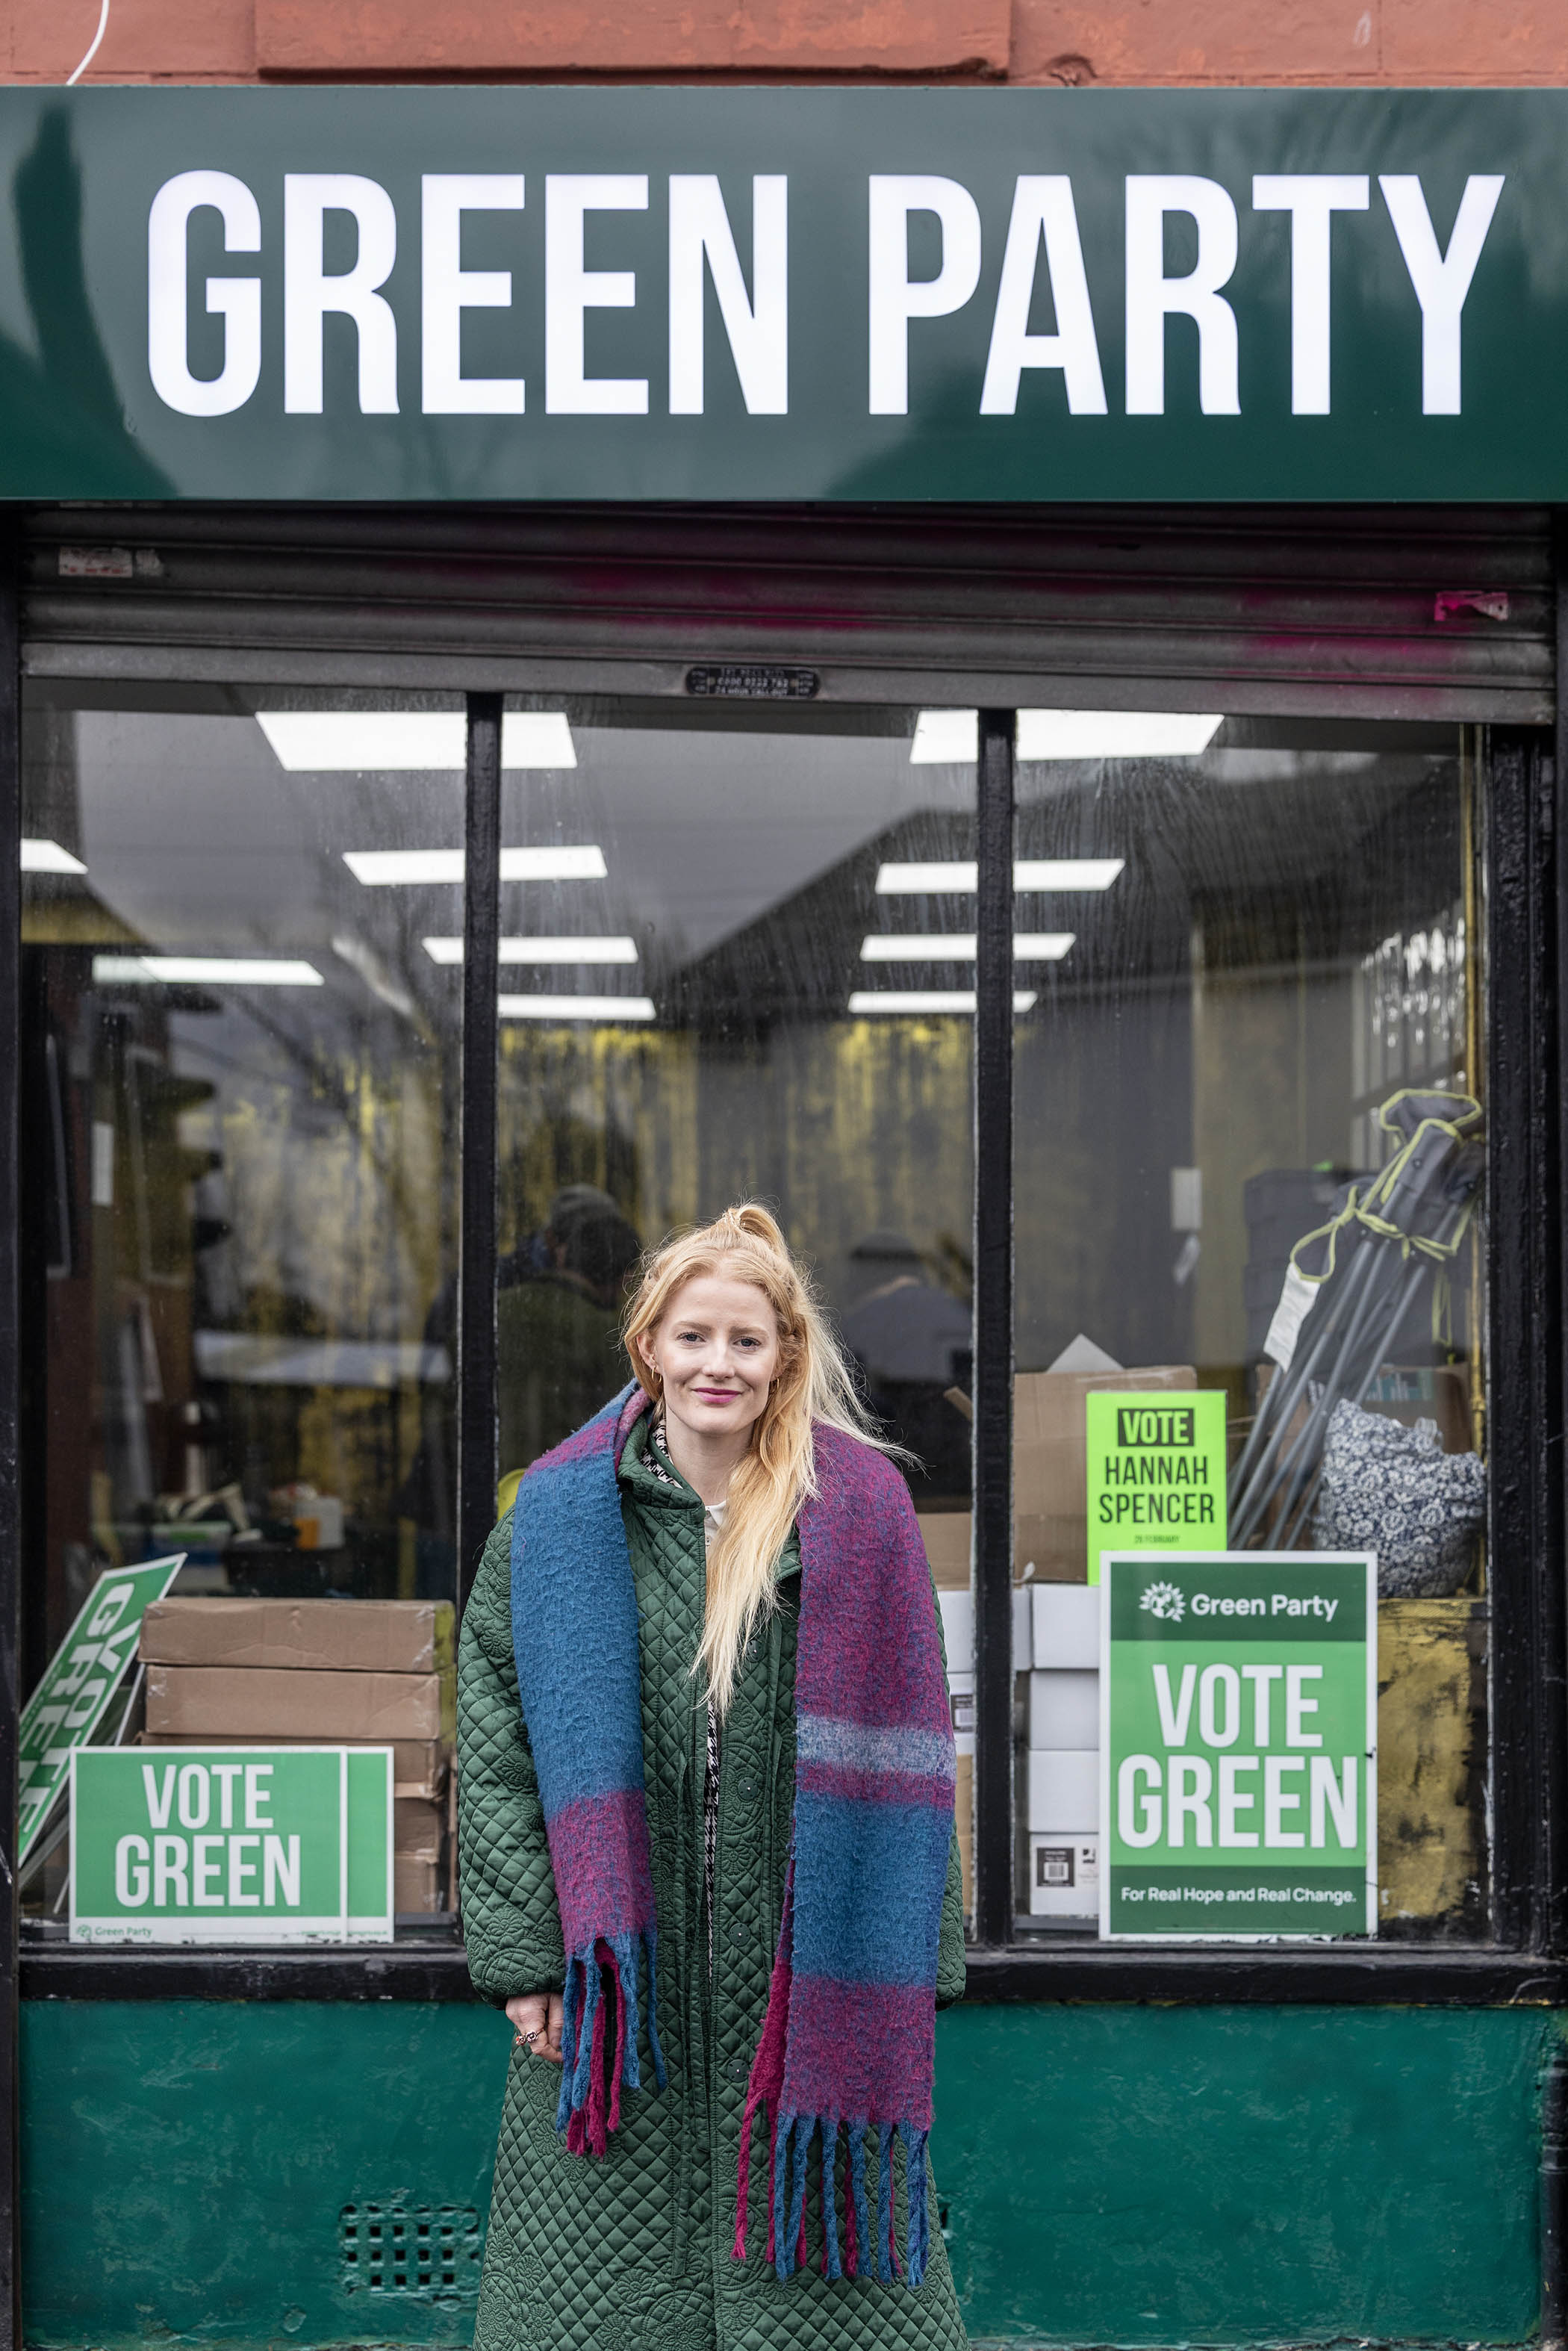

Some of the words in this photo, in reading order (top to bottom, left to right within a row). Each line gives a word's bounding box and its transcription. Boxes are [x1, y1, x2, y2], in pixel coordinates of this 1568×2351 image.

[148, 171, 788, 416] GREEN
[869, 175, 1505, 416] PARTY
[1122, 1411, 1189, 1444] VOTE
[1106, 1456, 1208, 1485] HANNAH
[1100, 1494, 1214, 1524] SPENCER
[1191, 1593, 1266, 1616] Green
[1271, 1594, 1339, 1622] Party
[19, 1583, 135, 1792] GRE
[1152, 1664, 1323, 1748] VOTE
[142, 1764, 274, 1829] VOTE
[1118, 1754, 1357, 1848] GREEN
[115, 1834, 301, 1907] GREEN
[1121, 1886, 1146, 1901] For
[1148, 1886, 1181, 1902] Real
[1184, 1887, 1225, 1905] Hope
[1226, 1887, 1256, 1902] and
[1258, 1887, 1291, 1903] Real
[1292, 1887, 1357, 1906] Change.
[95, 1926, 125, 1936] Green
[127, 1927, 152, 1938] Party
